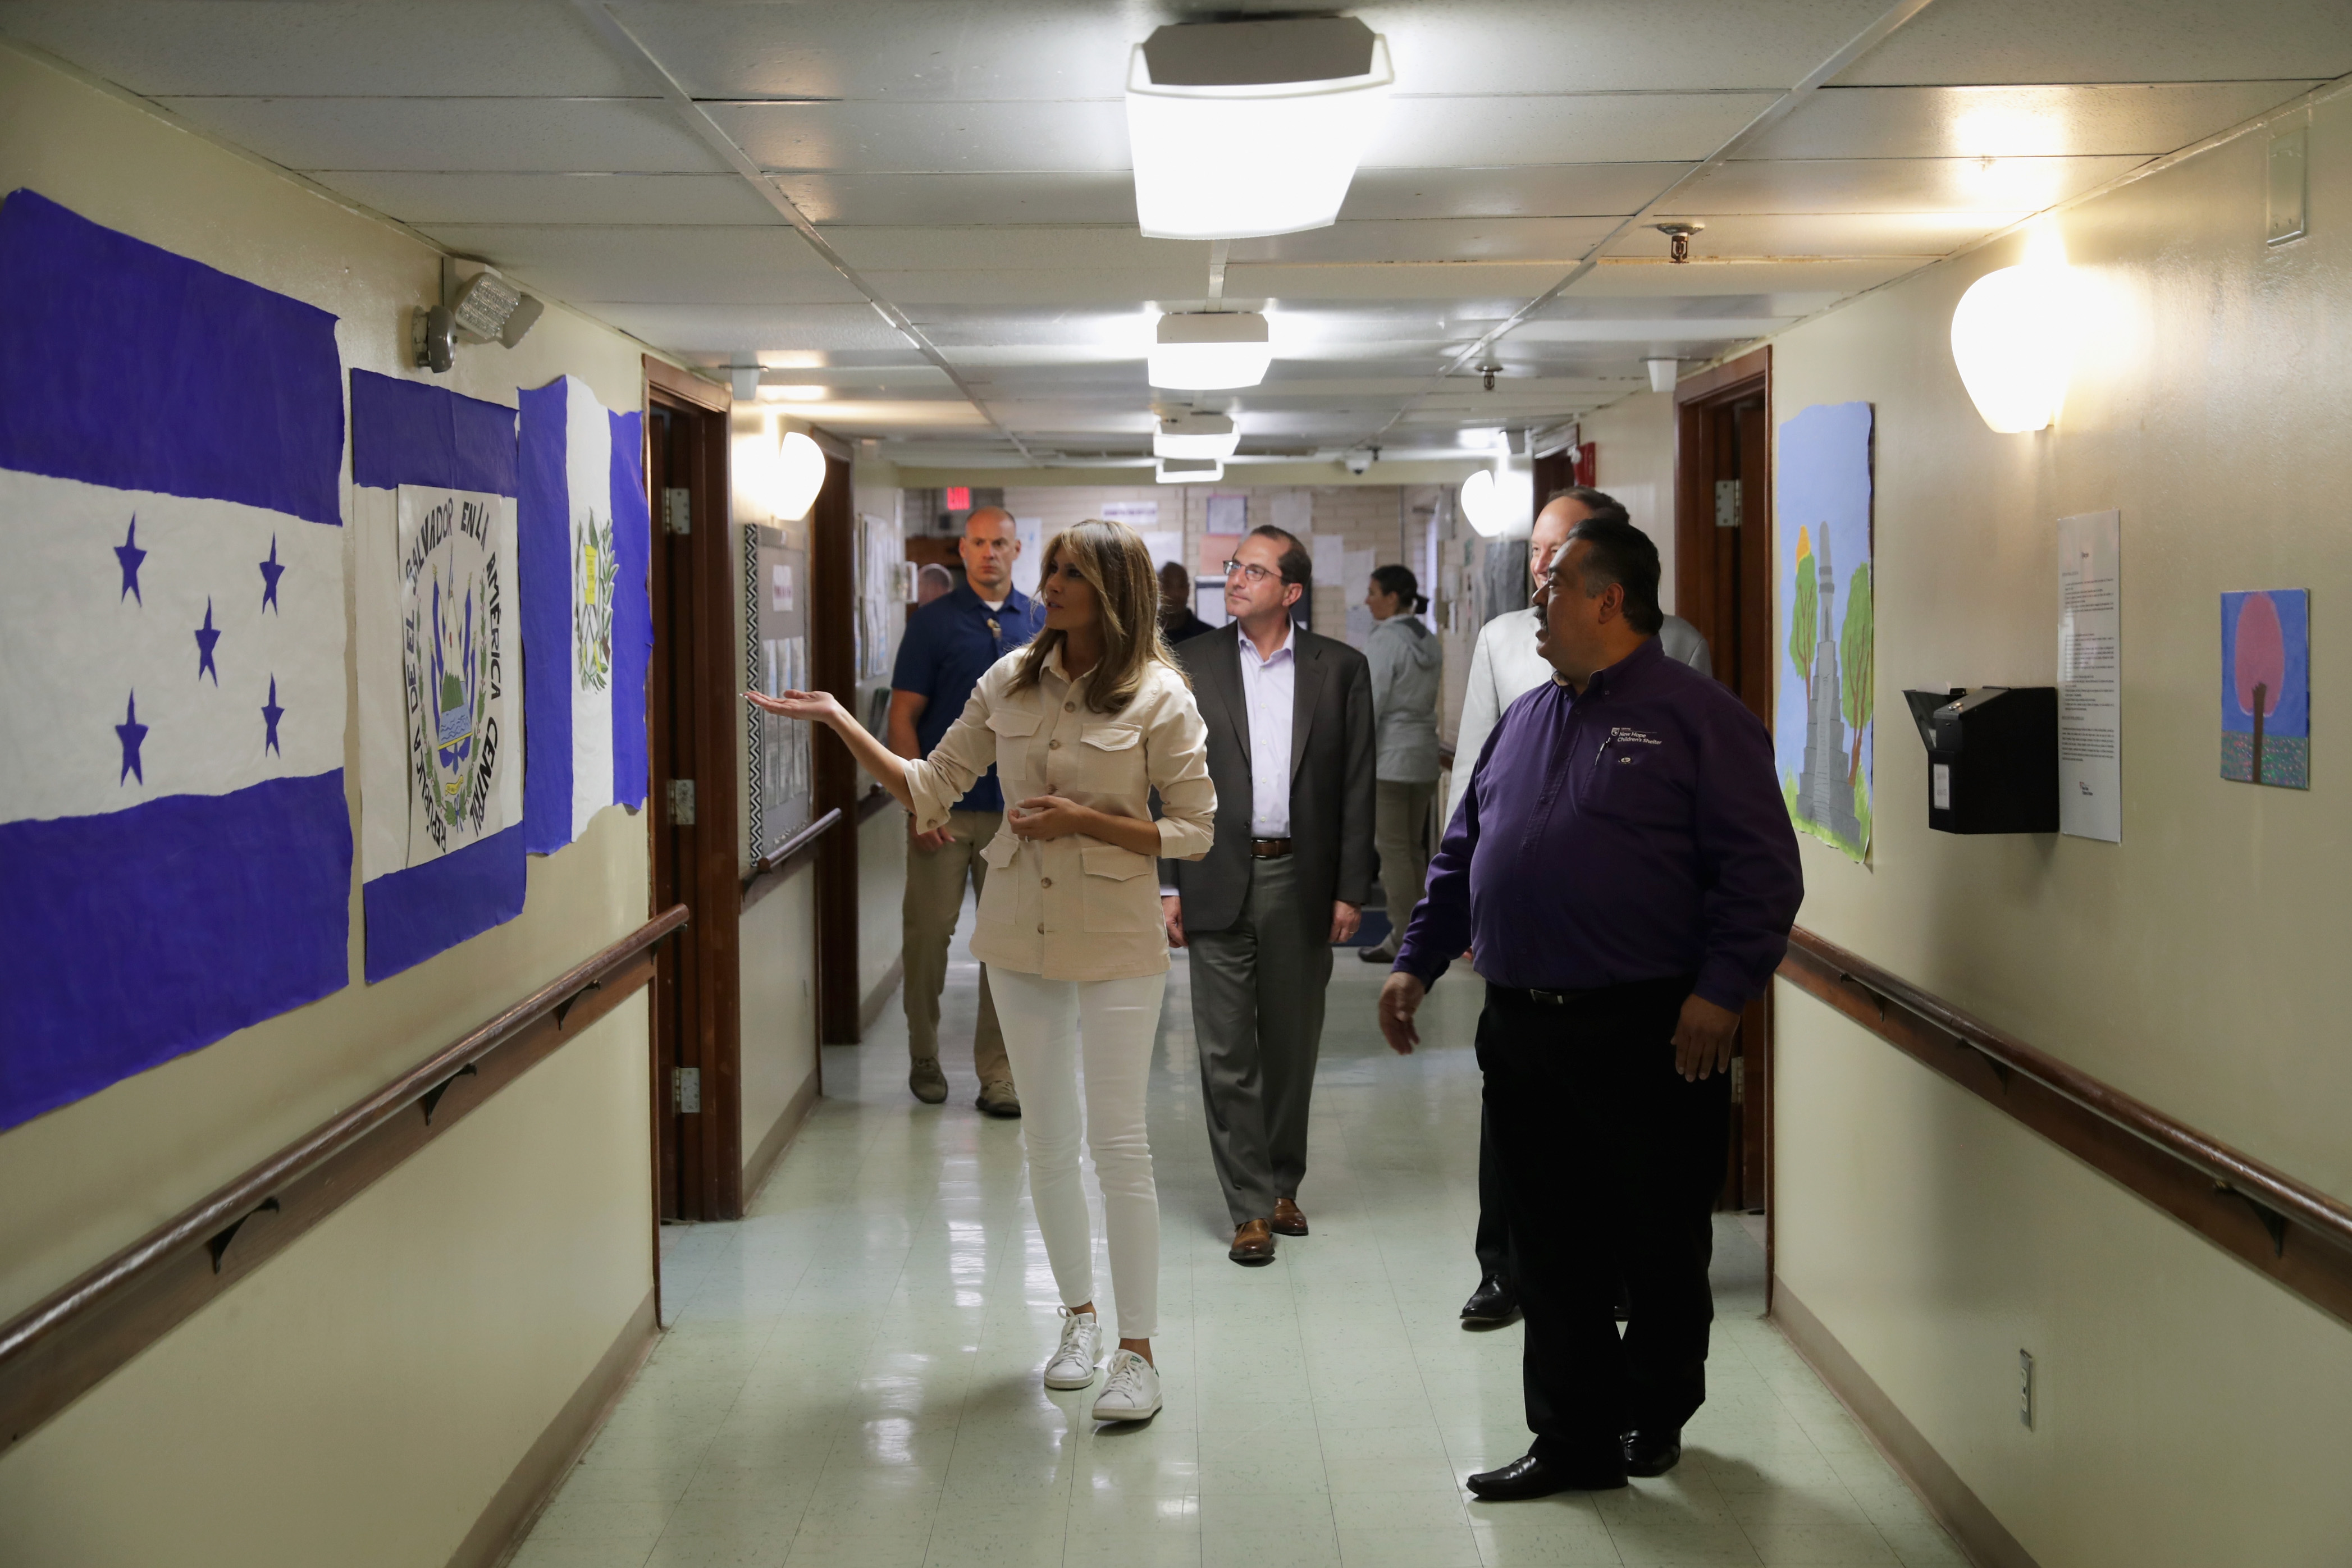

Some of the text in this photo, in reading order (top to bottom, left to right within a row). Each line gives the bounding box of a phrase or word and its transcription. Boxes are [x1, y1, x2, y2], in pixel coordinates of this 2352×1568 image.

[406, 497, 454, 596] SALVADOR
[406, 609, 415, 654] EL
[486, 551, 501, 700] AMÉRICA
[407, 662, 419, 714] DE
[469, 716, 498, 838] CENTRAL
